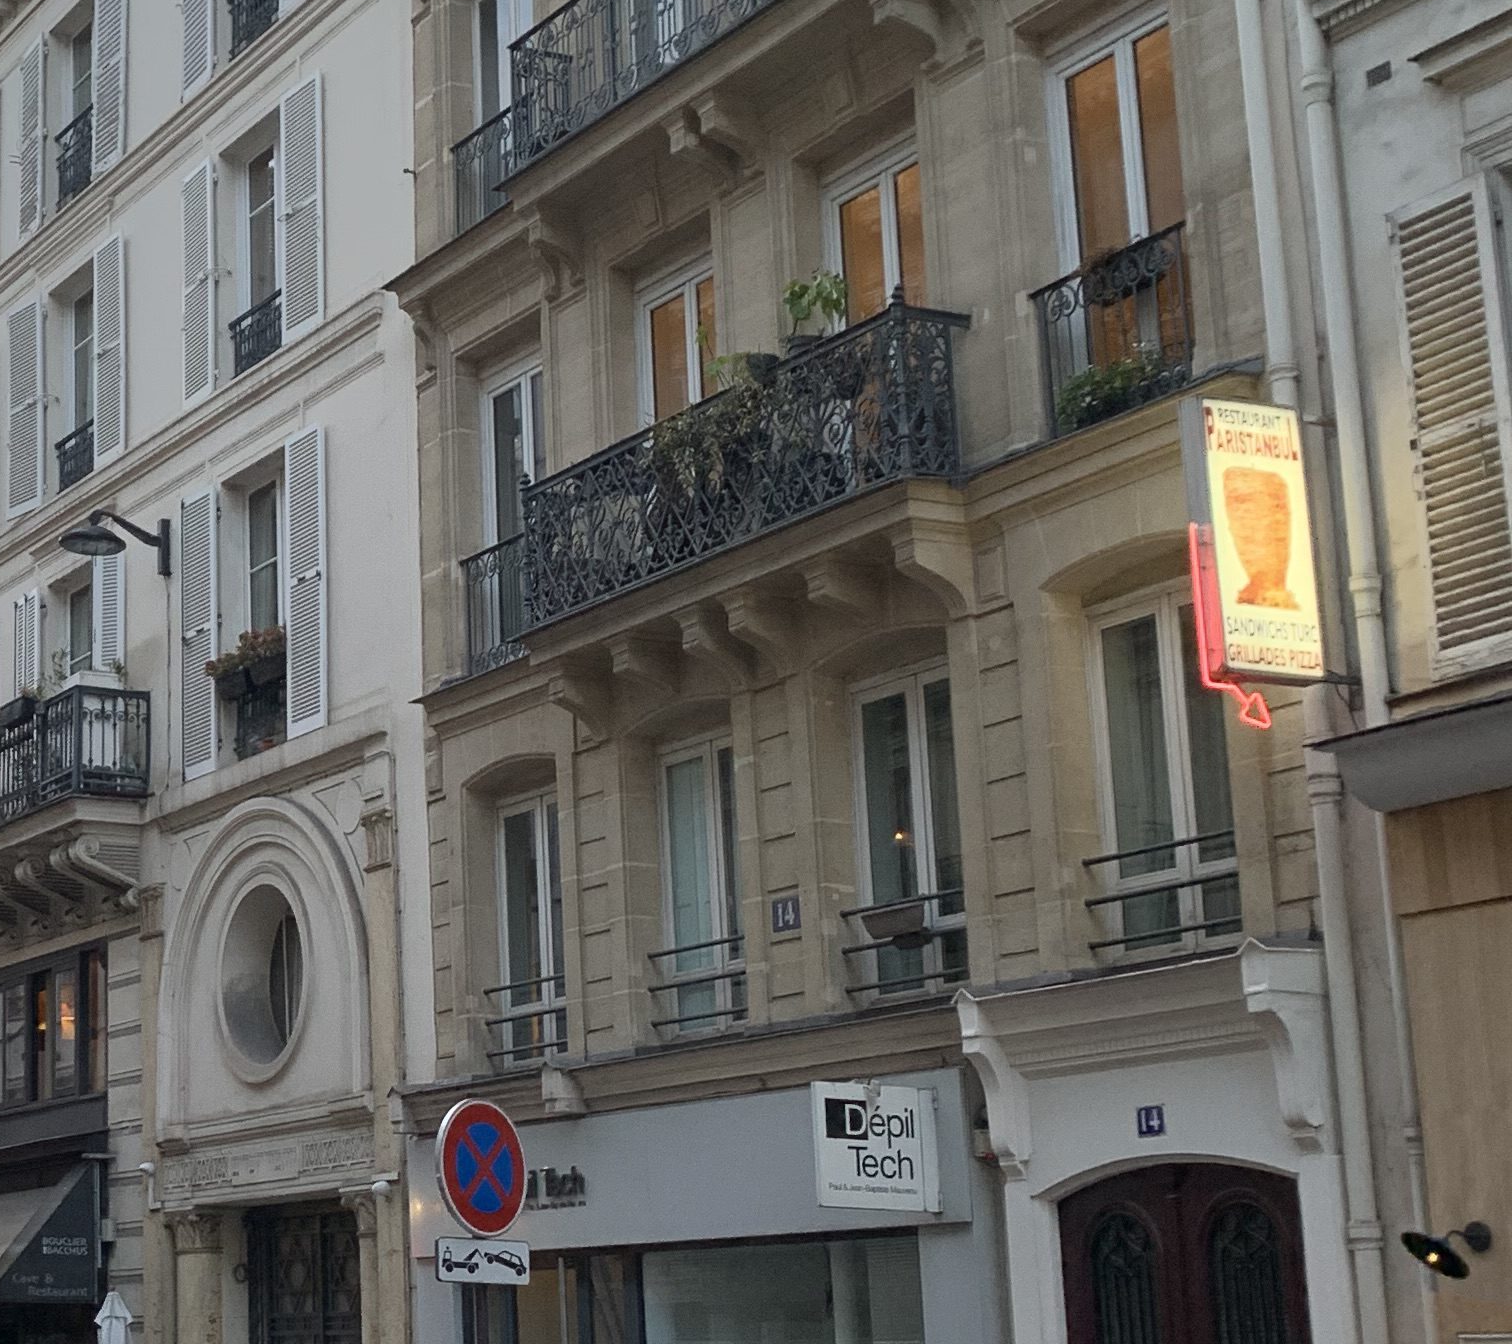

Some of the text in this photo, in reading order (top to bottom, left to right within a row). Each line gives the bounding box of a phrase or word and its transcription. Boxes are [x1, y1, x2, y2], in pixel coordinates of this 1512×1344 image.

[1218, 408, 1281, 429] RESTAURANT
[1204, 407, 1298, 461] PARISTANBUL
[1290, 622, 1319, 643] TURC
[1229, 643, 1322, 671] GRILLADES PIZZA
[777, 901, 795, 928] 14
[844, 1103, 915, 1149] Dépil
[1140, 1108, 1161, 1132] 14
[847, 1145, 914, 1180] Tech
